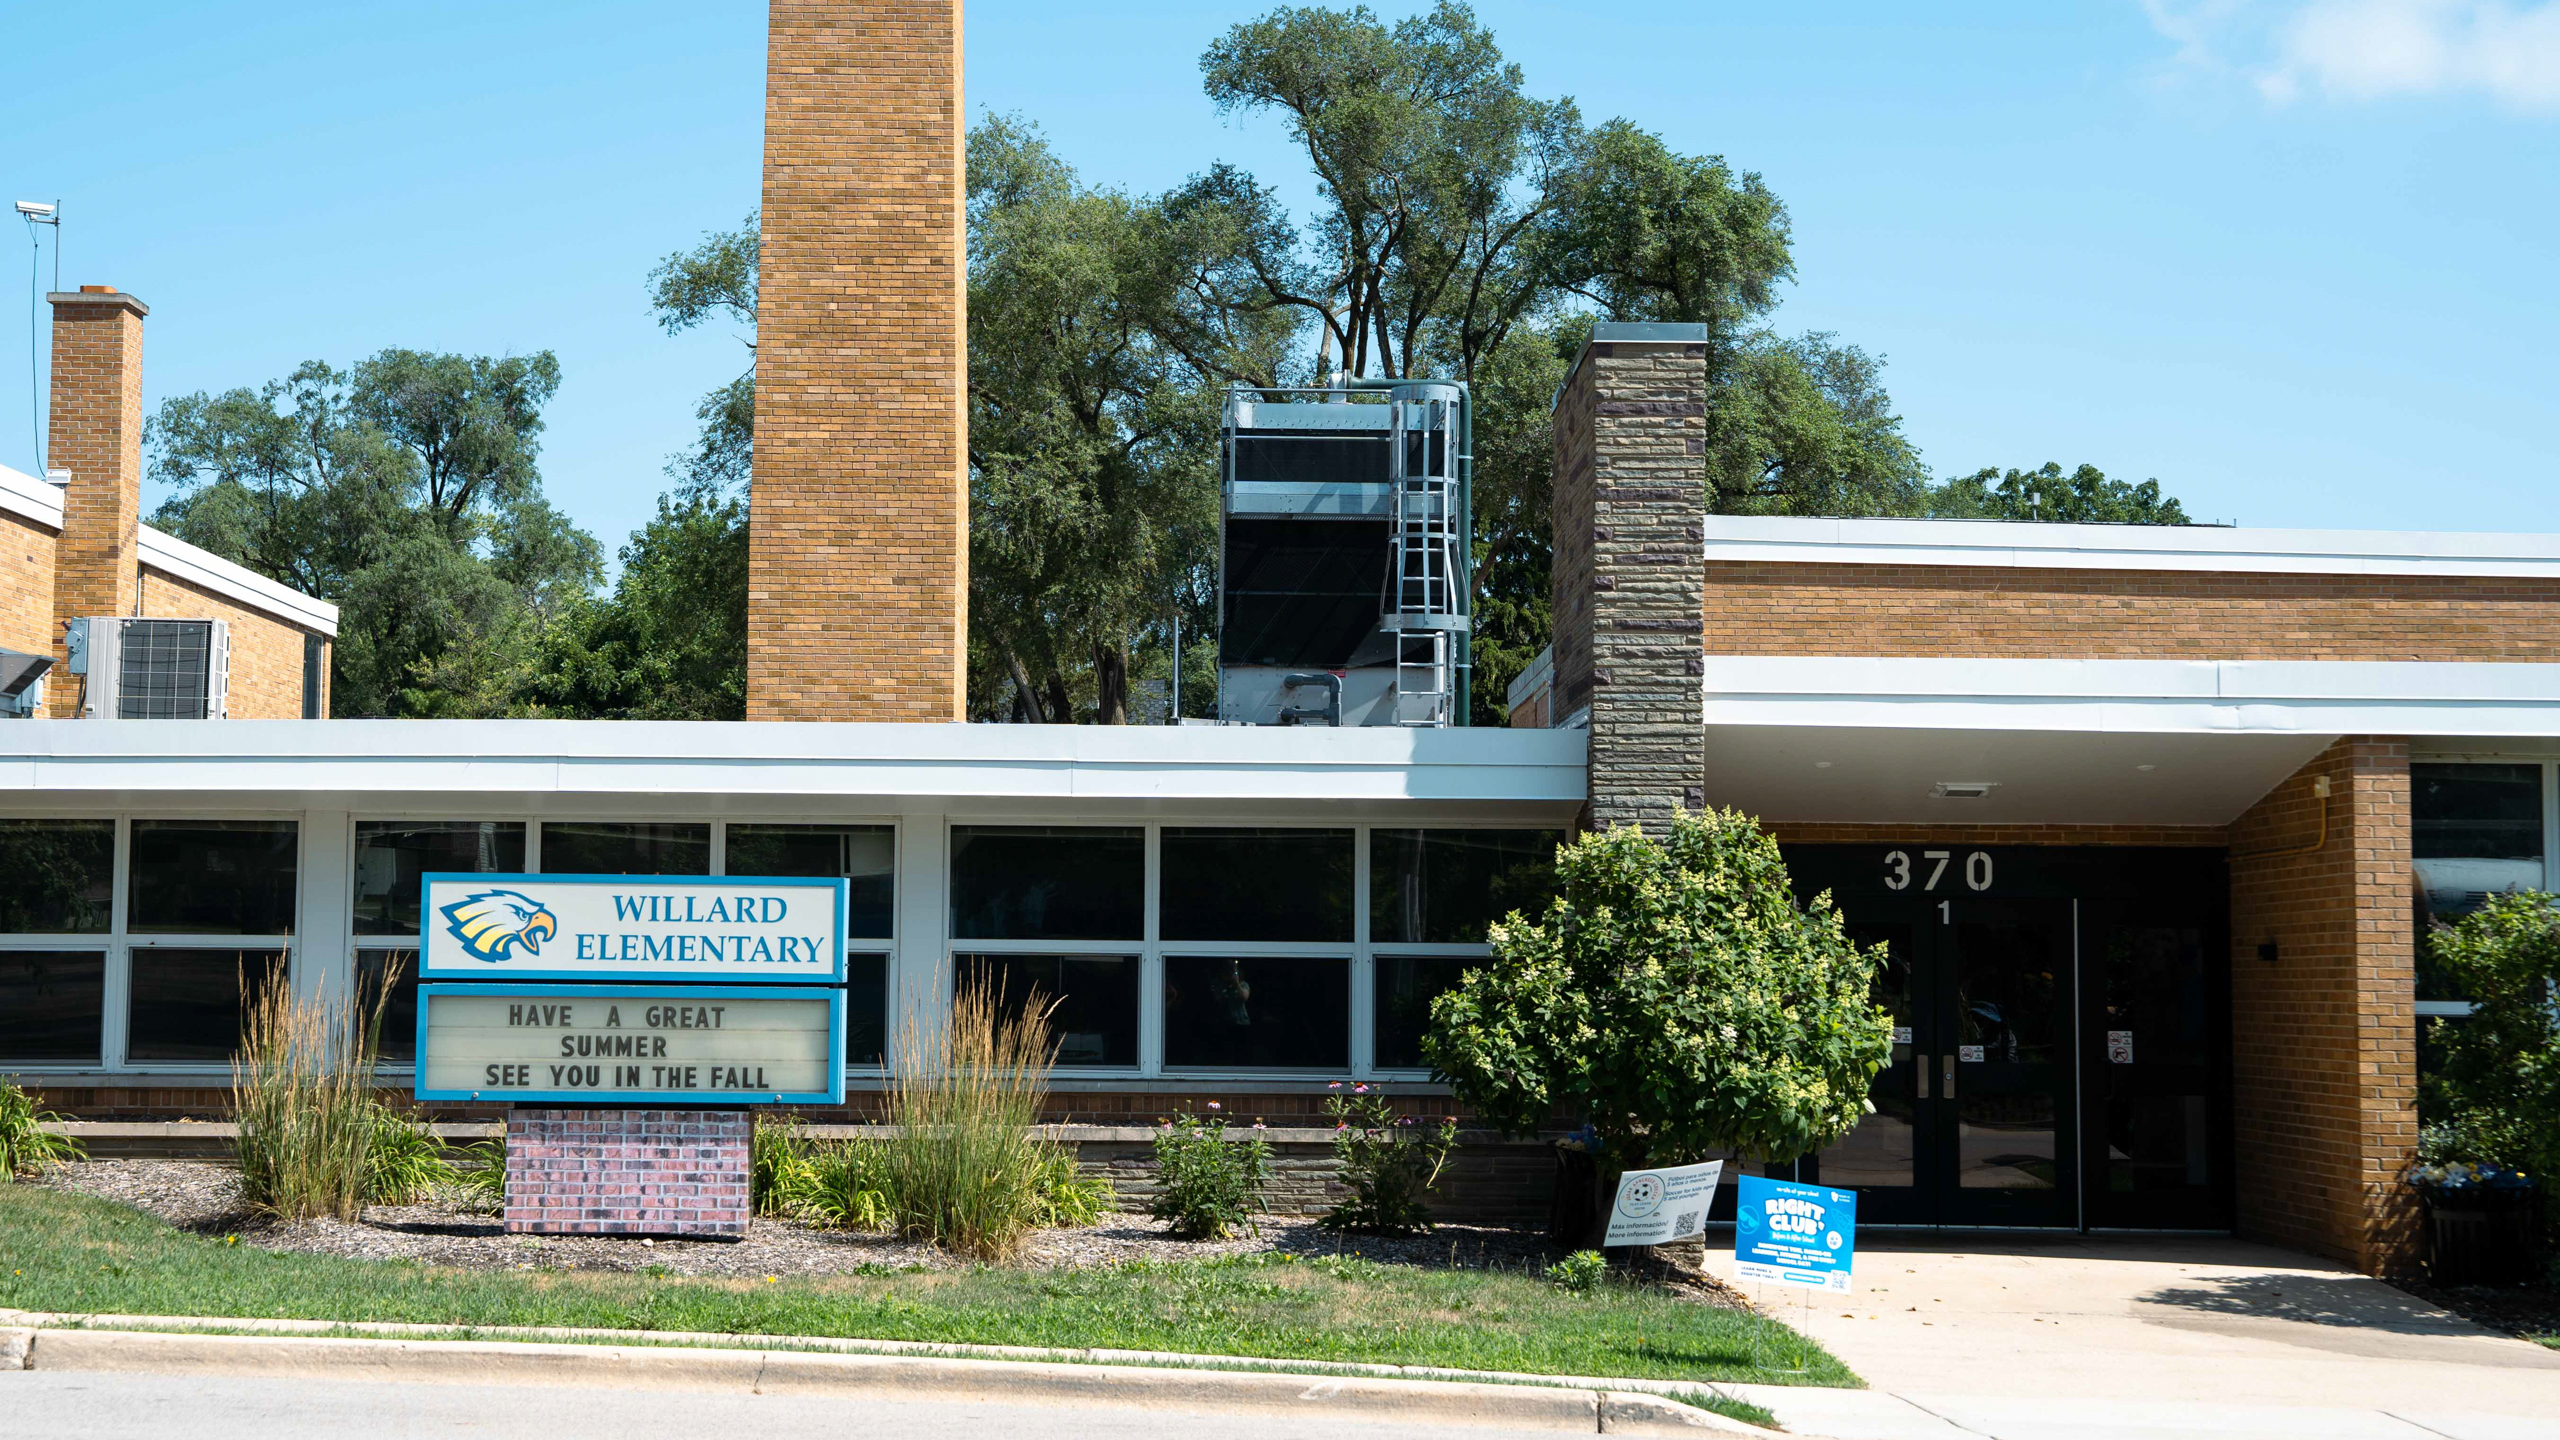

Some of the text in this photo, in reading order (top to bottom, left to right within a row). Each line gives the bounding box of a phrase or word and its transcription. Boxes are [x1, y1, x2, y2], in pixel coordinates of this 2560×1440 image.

[1884, 850, 1993, 891] 370
[613, 896, 788, 923] WILLARD
[1938, 900, 1950, 925] 1
[575, 933, 825, 963] ELEMENTARY
[509, 1004, 725, 1028] HAVE A GREAT
[561, 1035, 667, 1058] SUMMER
[486, 1064, 769, 1090] SEE YOU IN THE FALL
[1765, 1198, 1825, 1221] RIGHT
[1769, 1214, 1817, 1235] CLUB
